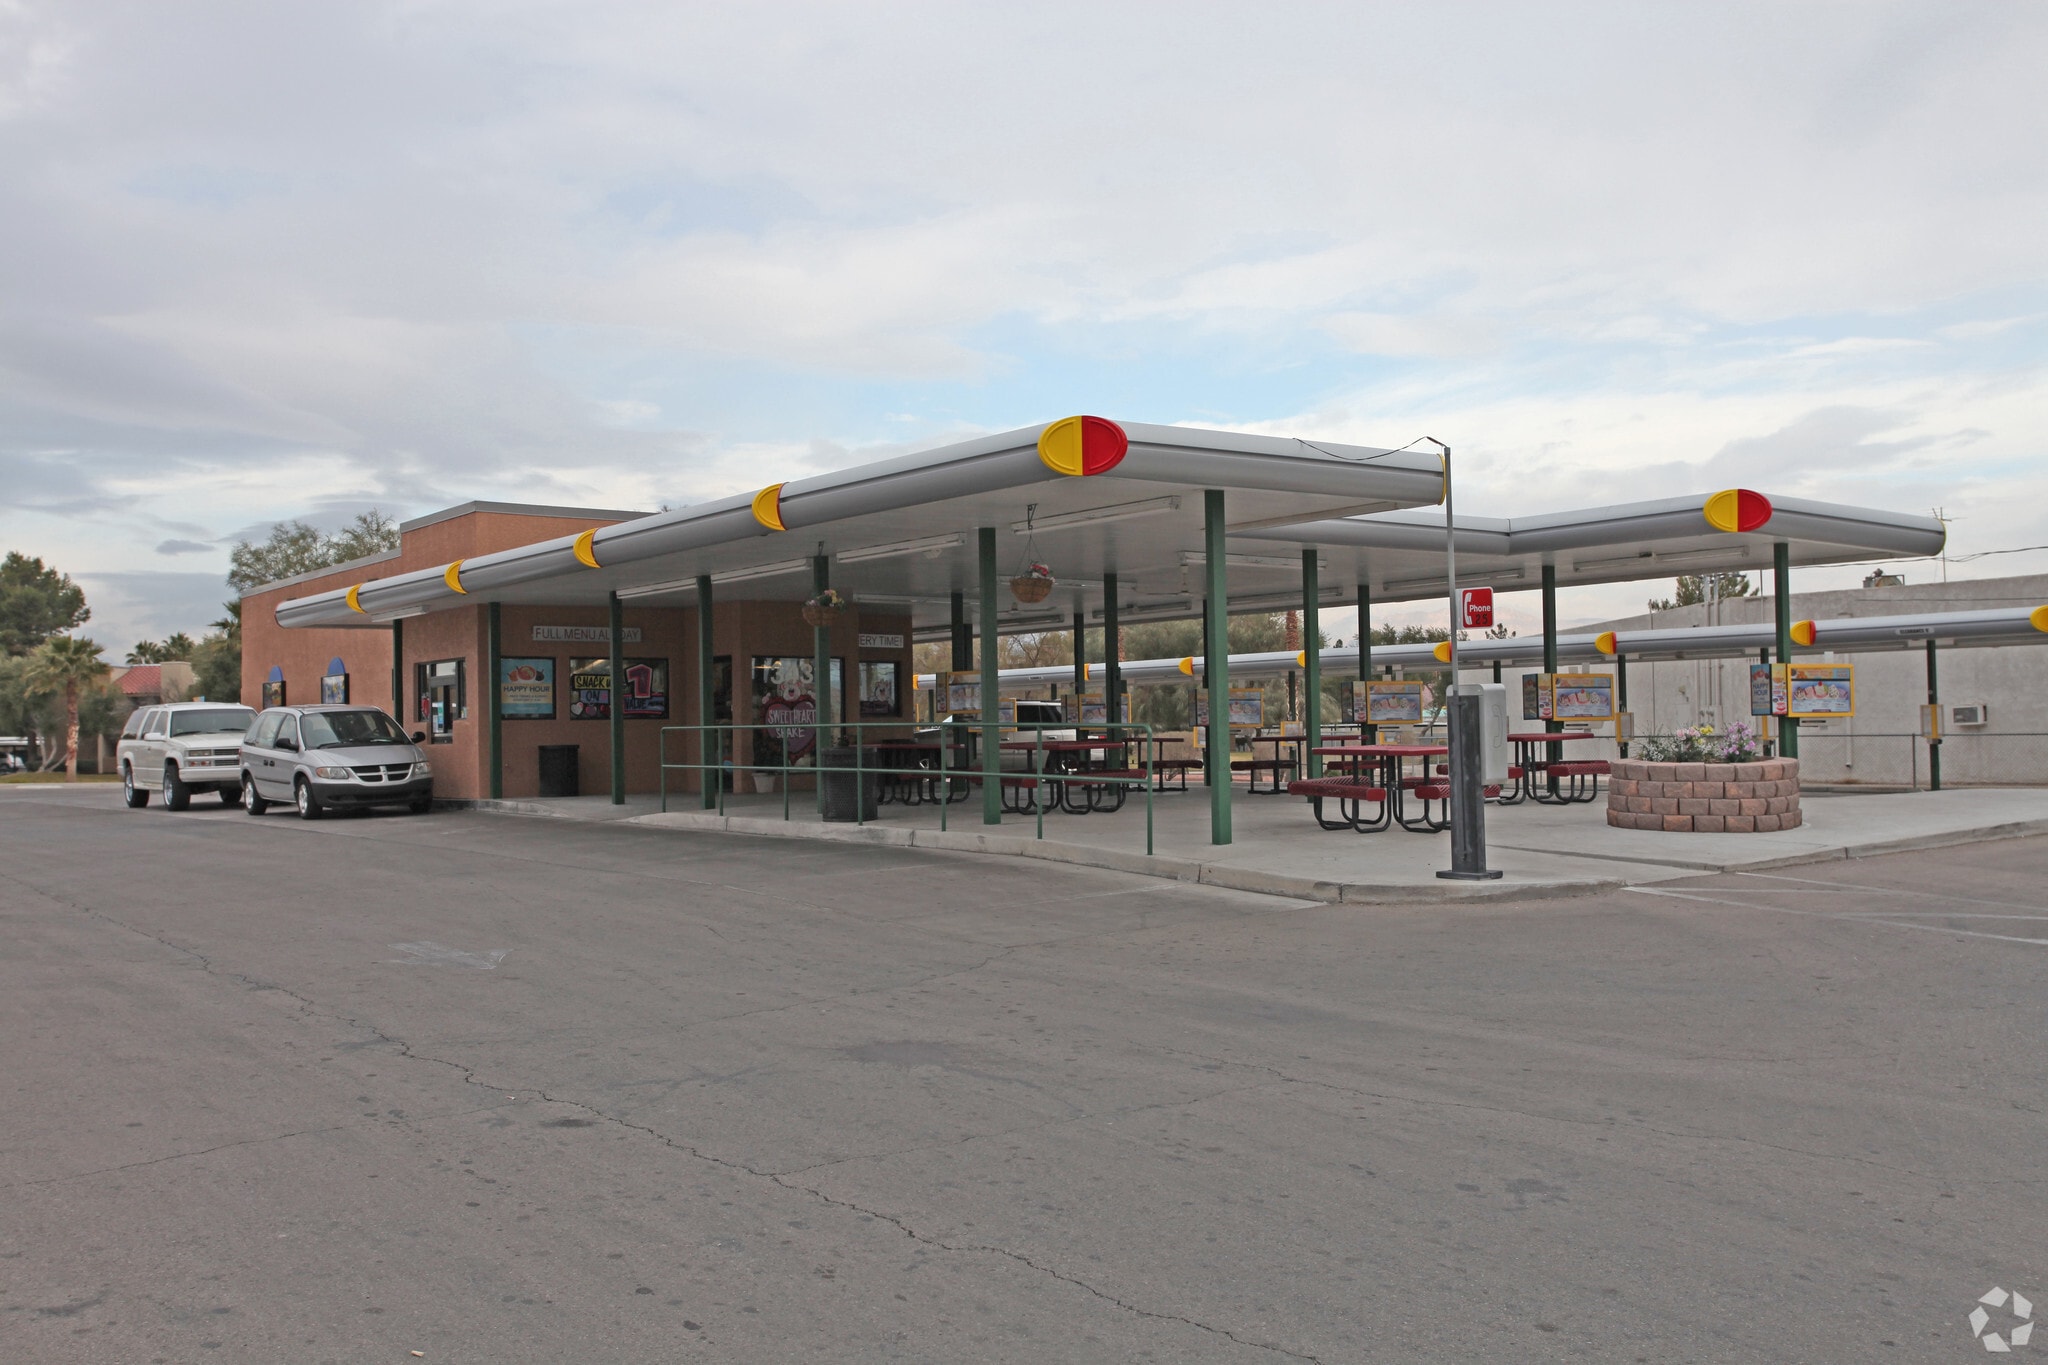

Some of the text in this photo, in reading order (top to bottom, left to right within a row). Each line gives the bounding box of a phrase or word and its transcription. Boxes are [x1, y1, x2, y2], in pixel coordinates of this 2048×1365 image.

[1469, 604, 1491, 612] Phone
[1475, 613, 1488, 624] 25
[535, 628, 561, 640] FULL
[564, 628, 596, 640] MENU
[598, 629, 610, 640] AL
[860, 635, 903, 647] ERY TIME!
[576, 675, 605, 688] SNACK
[626, 663, 652, 698] 1
[585, 690, 600, 702] ON
[768, 709, 816, 724] SWEETHEART
